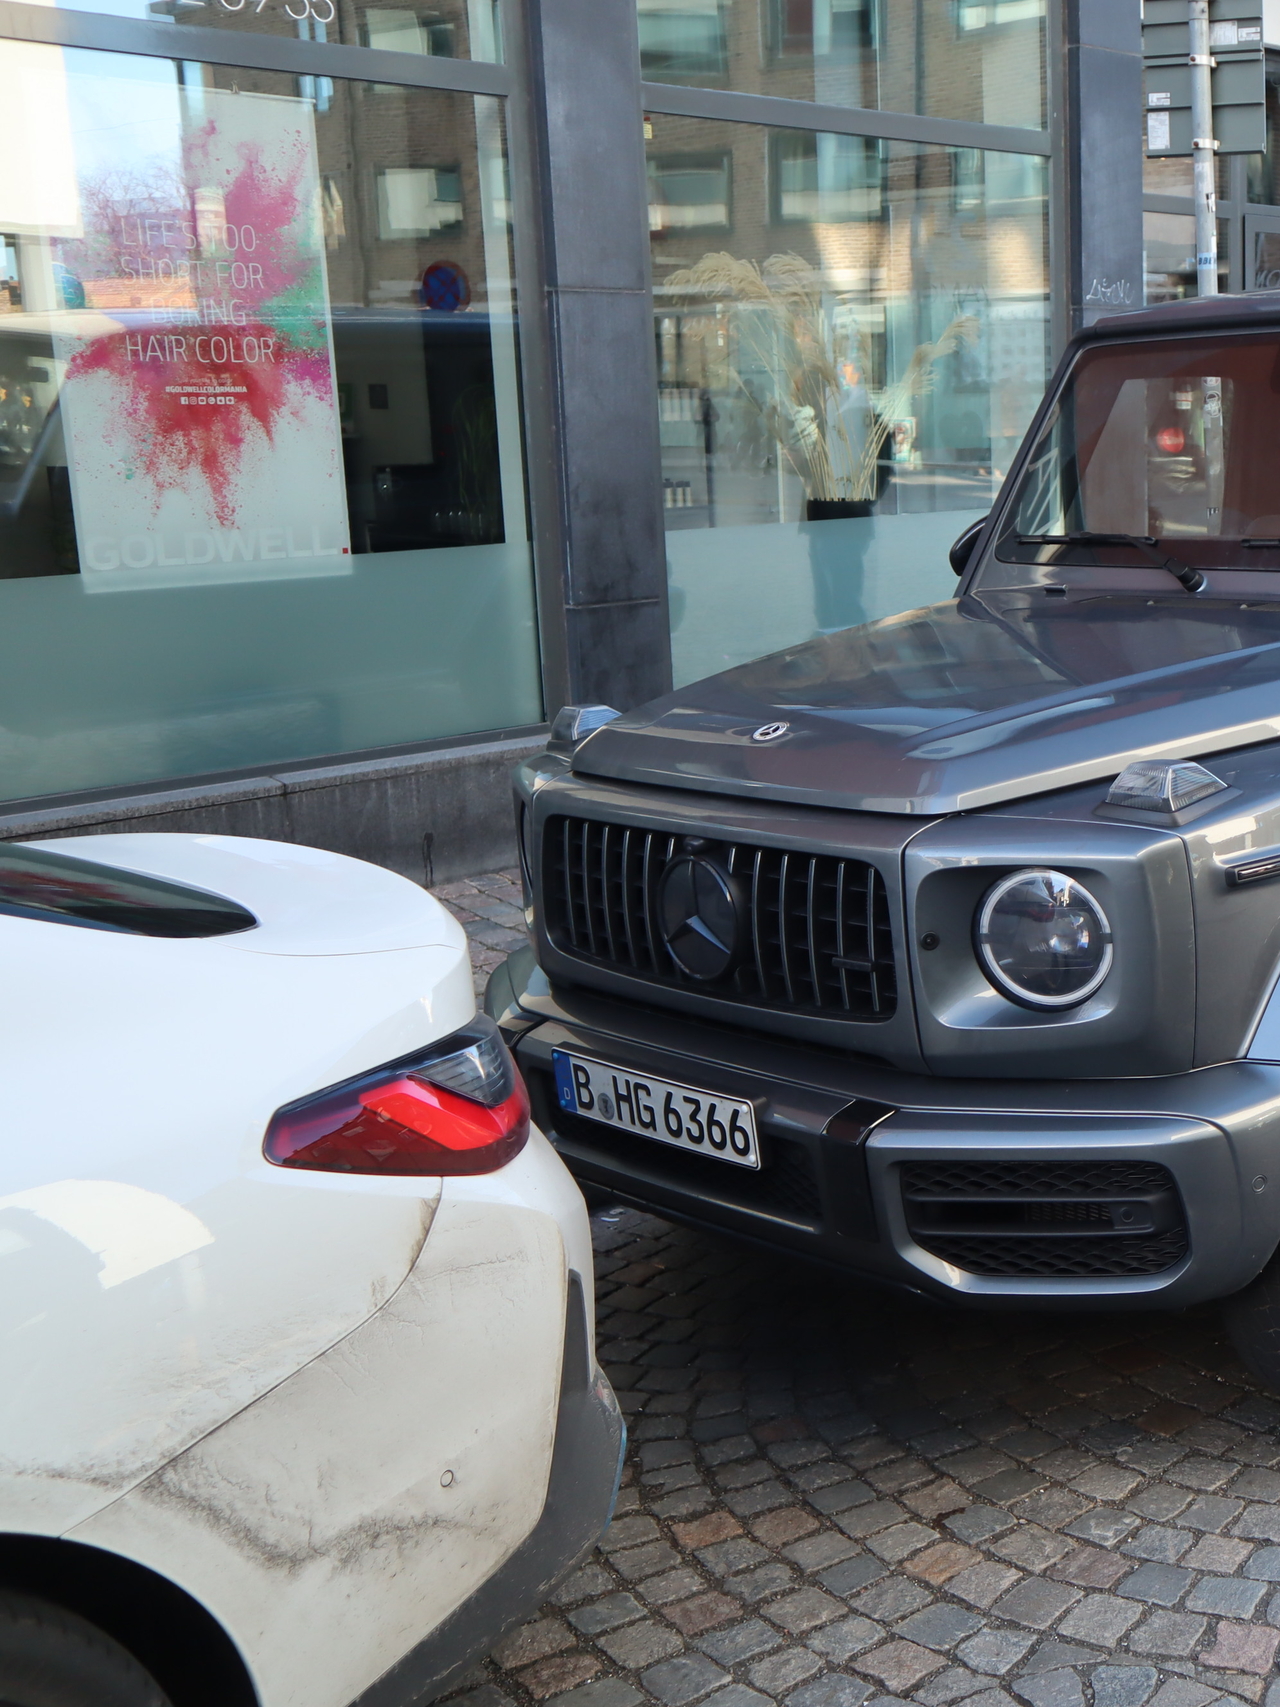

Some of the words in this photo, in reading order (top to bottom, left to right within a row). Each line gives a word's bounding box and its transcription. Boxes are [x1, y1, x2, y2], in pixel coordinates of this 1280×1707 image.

[121, 218, 197, 249] LIFE'S
[204, 223, 256, 253] TOO
[121, 257, 204, 286] SHORT
[215, 262, 264, 289] FOR
[151, 298, 246, 326] BORING
[126, 335, 188, 362] HAIR
[195, 336, 275, 363] COLOR
[165, 385, 248, 393] #GOLDWELLCOLORMANIA
[563, 1087, 571, 1100] D
[572, 1062, 595, 1111] B
[611, 1074, 657, 1132] HG
[663, 1090, 750, 1157] 6366
